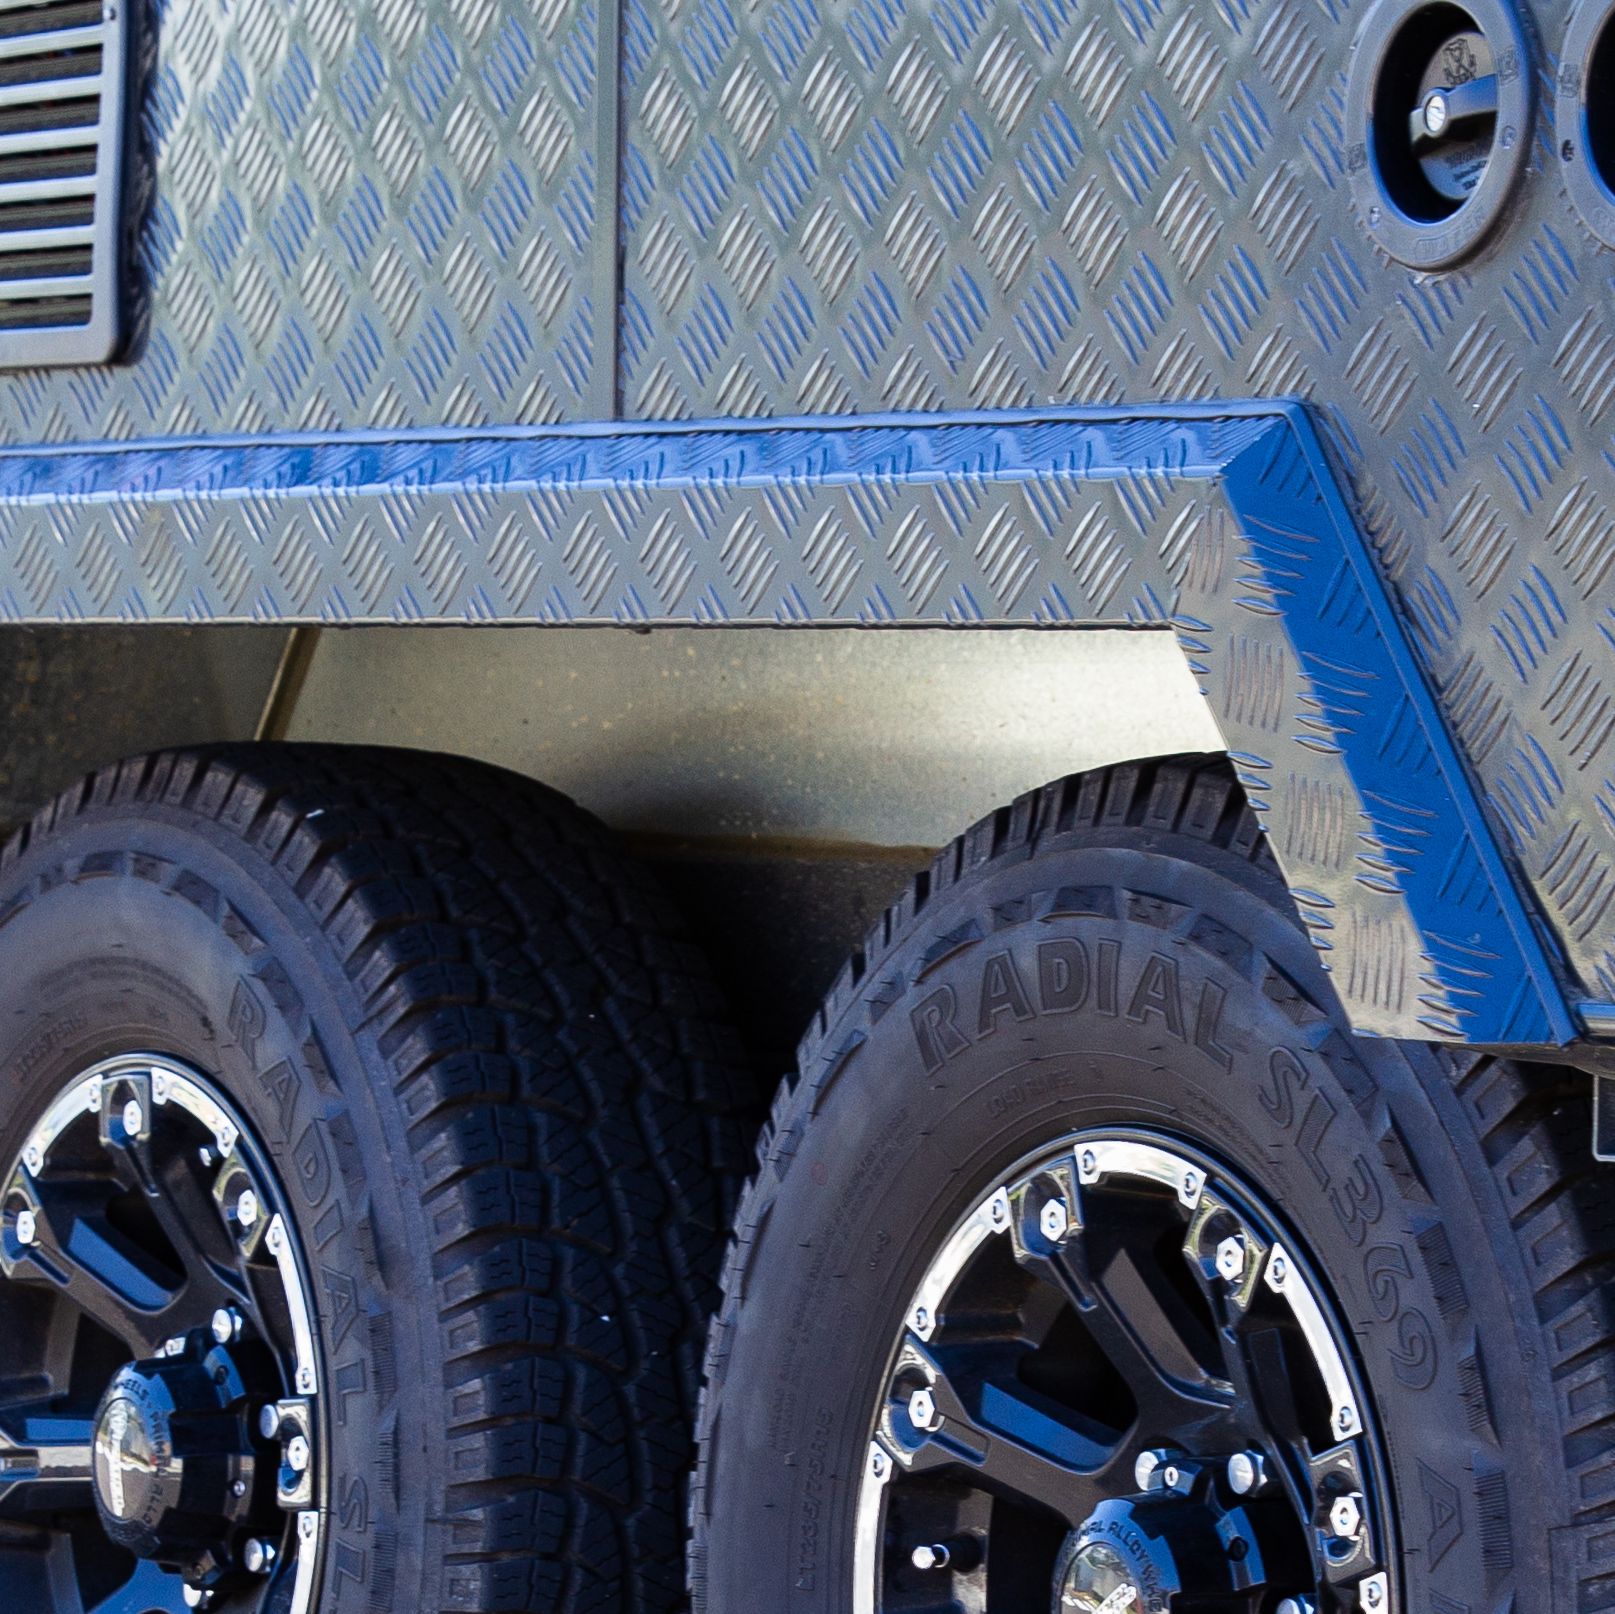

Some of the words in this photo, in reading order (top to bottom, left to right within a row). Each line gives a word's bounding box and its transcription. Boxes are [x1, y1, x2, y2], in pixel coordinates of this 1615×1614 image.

[227, 976, 368, 1426] RADIAL
[909, 936, 1236, 1073] RADIAL
[1257, 1043, 1441, 1394] SL369
